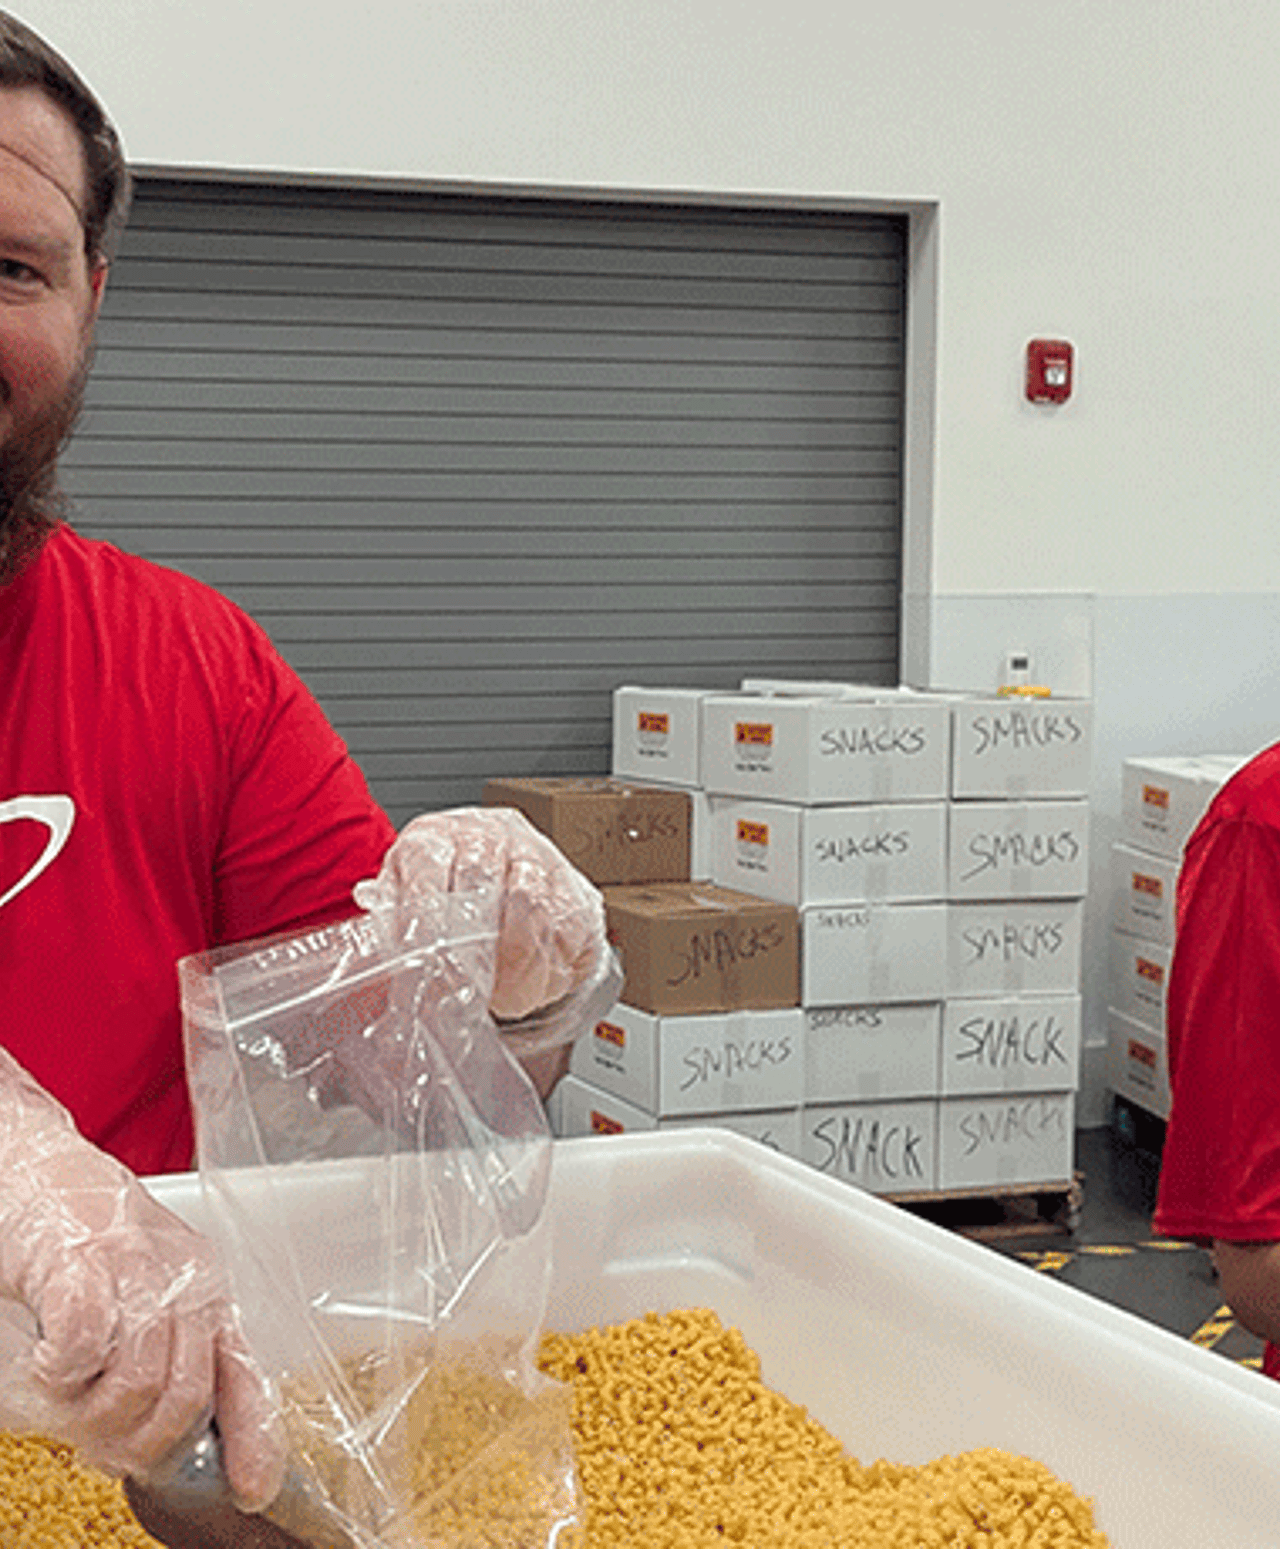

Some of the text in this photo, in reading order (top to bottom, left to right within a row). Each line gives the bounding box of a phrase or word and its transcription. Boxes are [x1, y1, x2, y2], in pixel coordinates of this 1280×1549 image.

[820, 726, 926, 756] SNACKS
[679, 1036, 792, 1092] SNACKS
[955, 1016, 1069, 1067] SNACK
[812, 1116, 924, 1180] SNACK
